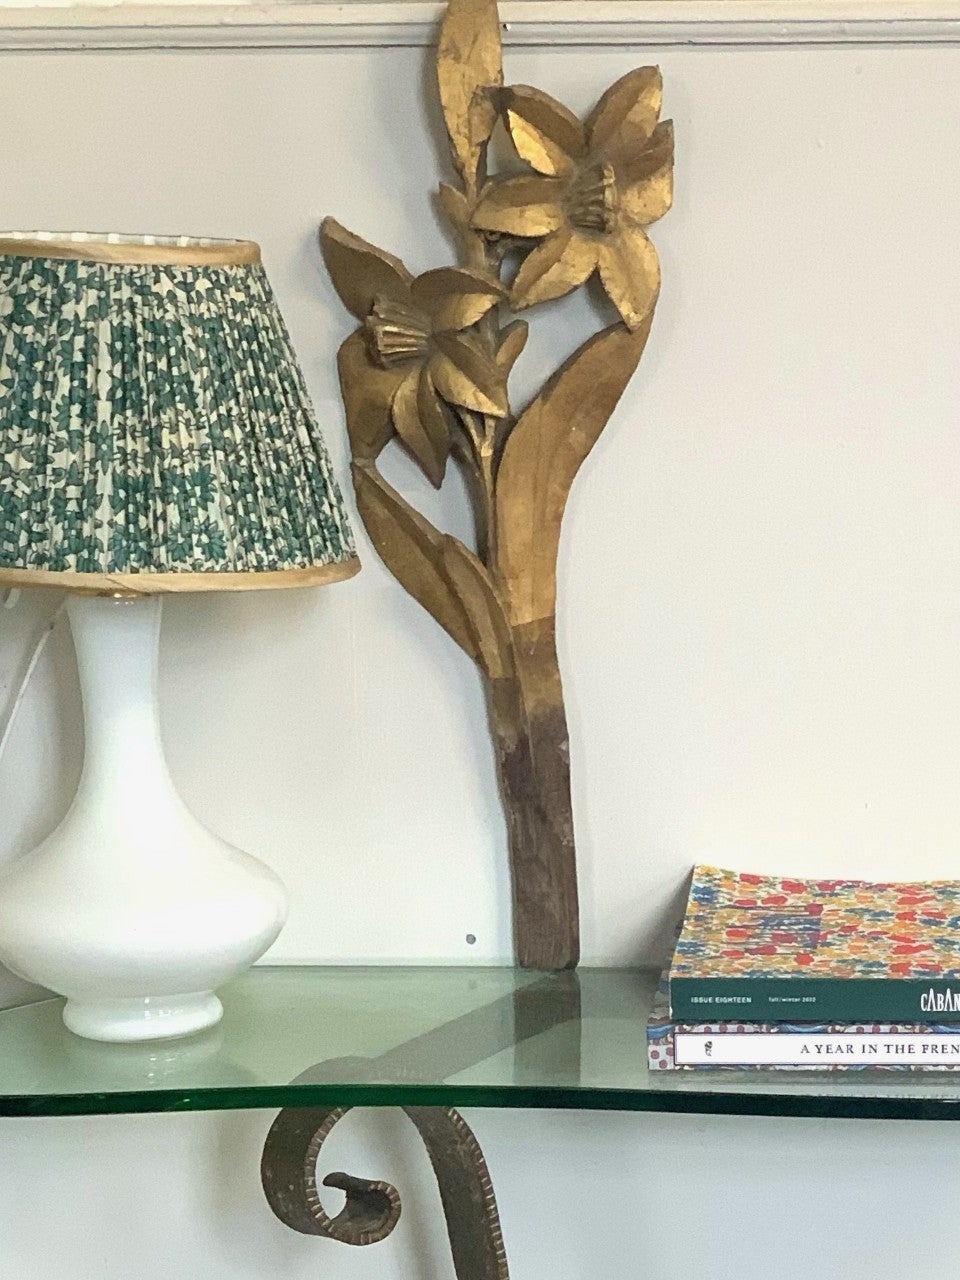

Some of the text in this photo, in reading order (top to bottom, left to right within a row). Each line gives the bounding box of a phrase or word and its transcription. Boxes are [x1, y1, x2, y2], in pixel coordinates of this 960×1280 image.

[800, 1044, 810, 1054] A
[814, 1044, 855, 1055] YEAR
[861, 1044, 878, 1055] IN
[883, 1044, 916, 1055] THE
